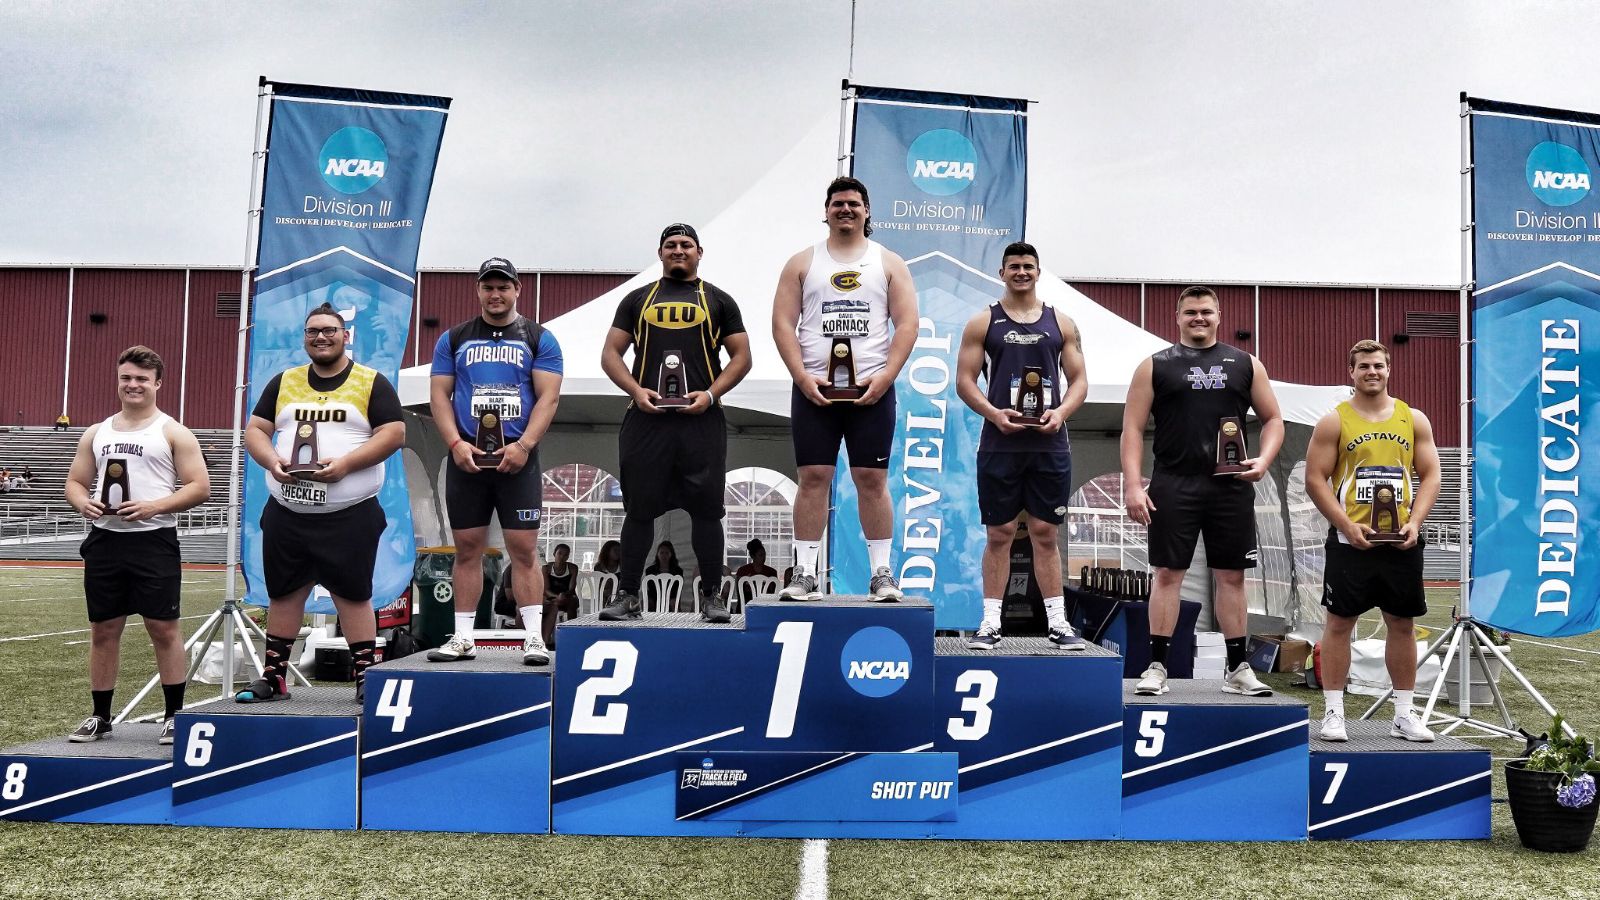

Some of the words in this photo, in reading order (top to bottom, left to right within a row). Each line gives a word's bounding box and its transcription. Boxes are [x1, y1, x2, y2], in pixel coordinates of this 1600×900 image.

[324, 158, 385, 178] NCAA
[912, 159, 976, 181] NCAA
[1533, 170, 1591, 190] NCAA
[303, 195, 373, 217] Division
[379, 200, 392, 217] III
[893, 200, 966, 220] Division
[971, 204, 984, 221] III
[275, 216, 320, 226] DISCOVER
[324, 219, 368, 229] DEVELOP
[372, 219, 413, 229] DEDICATE
[916, 223, 961, 232] DEVELOP
[965, 226, 1011, 236] DEDICATE
[1515, 210, 1587, 230] Division
[1487, 232, 1534, 241] DISCOVER
[1539, 233, 1582, 242] DEVELOP
[654, 306, 696, 323] TLU
[823, 319, 870, 333] KORNACK
[465, 345, 524, 369] DUBUQUE
[1190, 365, 1226, 390] M
[294, 409, 347, 423] UWO
[101, 444, 112, 457] ST.
[114, 443, 144, 457] THOMAS
[1346, 432, 1411, 452] GUSTAVUS
[899, 317, 952, 592] DEVELOP
[1535, 319, 1581, 617] DEDICATE
[280, 484, 327, 503] SHECKLER
[765, 621, 814, 739] 1
[847, 660, 909, 680] NCAA
[568, 640, 639, 735] 2
[374, 679, 414, 733] 4
[946, 669, 999, 741] 3
[1134, 710, 1169, 757] 5
[184, 722, 216, 767] 6
[1, 762, 28, 800] 8
[701, 773, 723, 781] TRACK
[729, 773, 748, 781] FIELD
[1321, 762, 1349, 805] 7
[870, 781, 917, 800] SHOT
[919, 781, 954, 800] PUT
